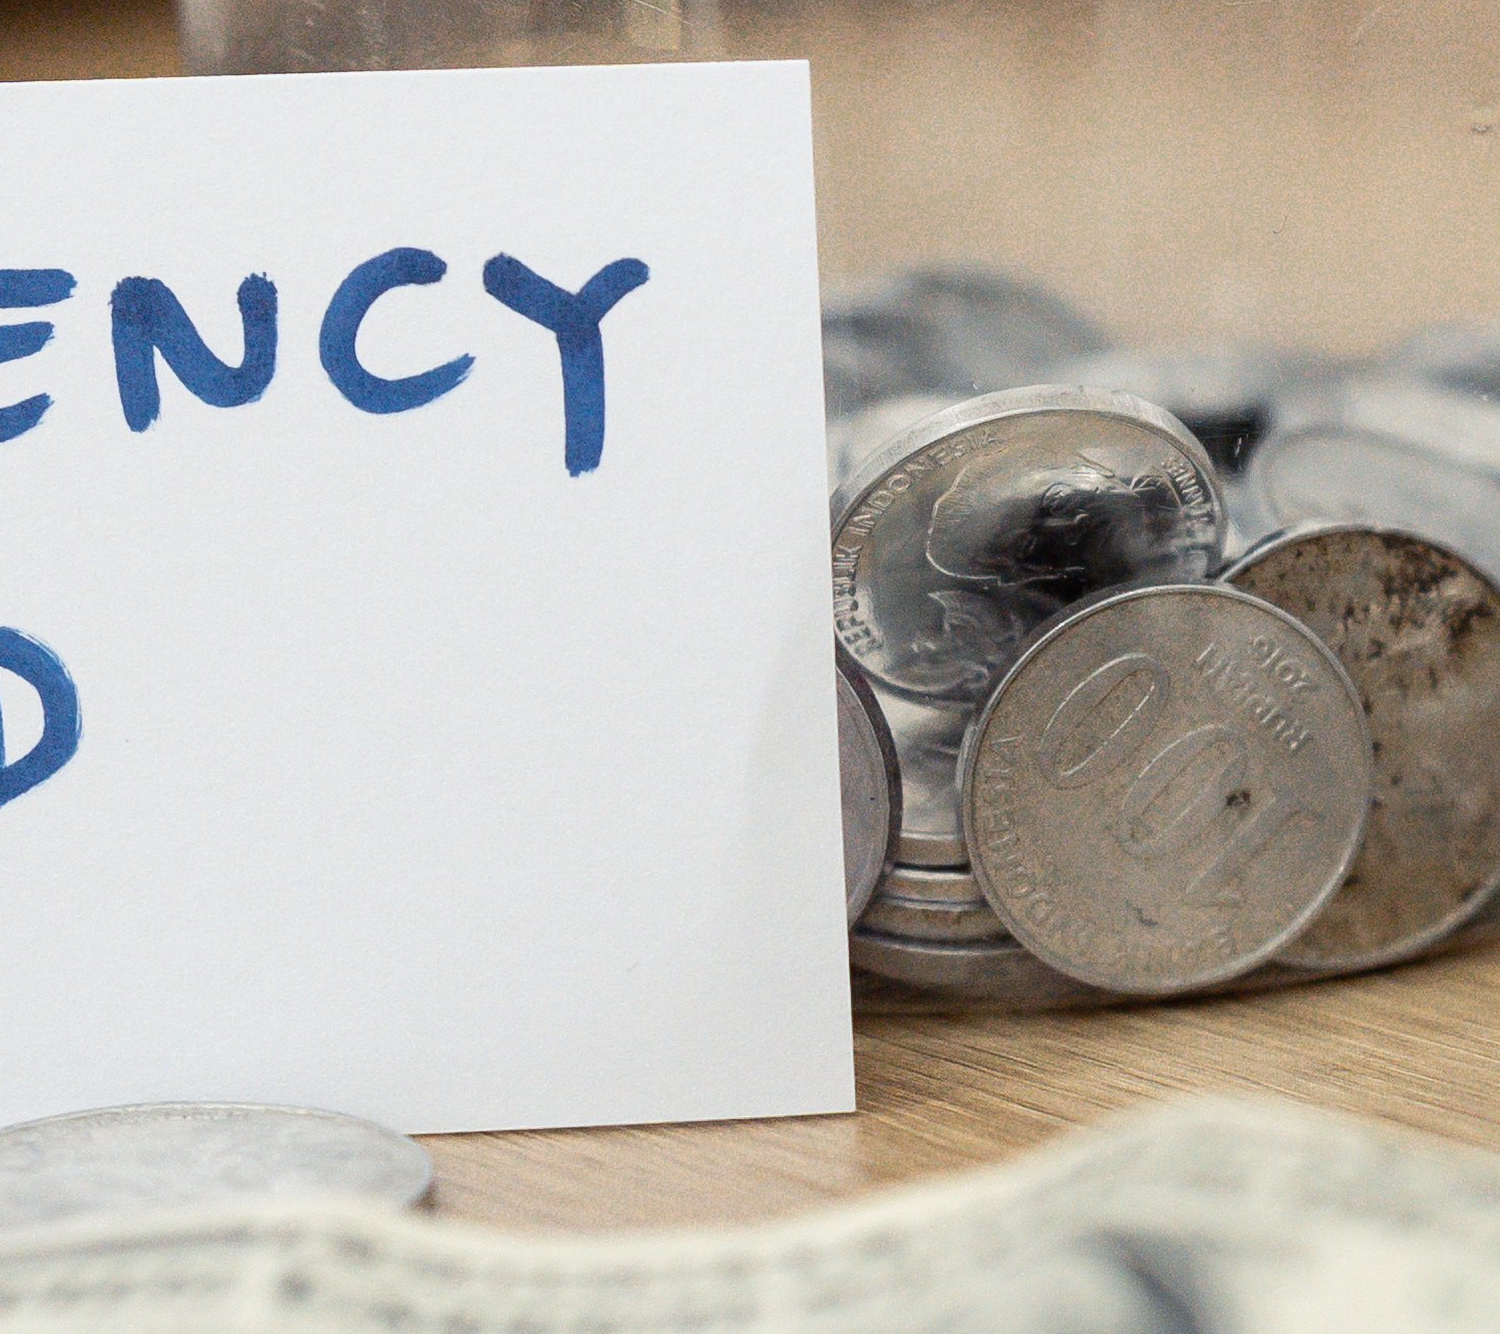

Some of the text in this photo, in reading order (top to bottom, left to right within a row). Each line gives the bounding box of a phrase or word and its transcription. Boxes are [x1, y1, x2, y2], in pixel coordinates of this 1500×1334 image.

[850, 426, 1008, 538] INDONESIA
[1195, 641, 1316, 754] RUPIAH
[1038, 651, 1328, 910] 100
